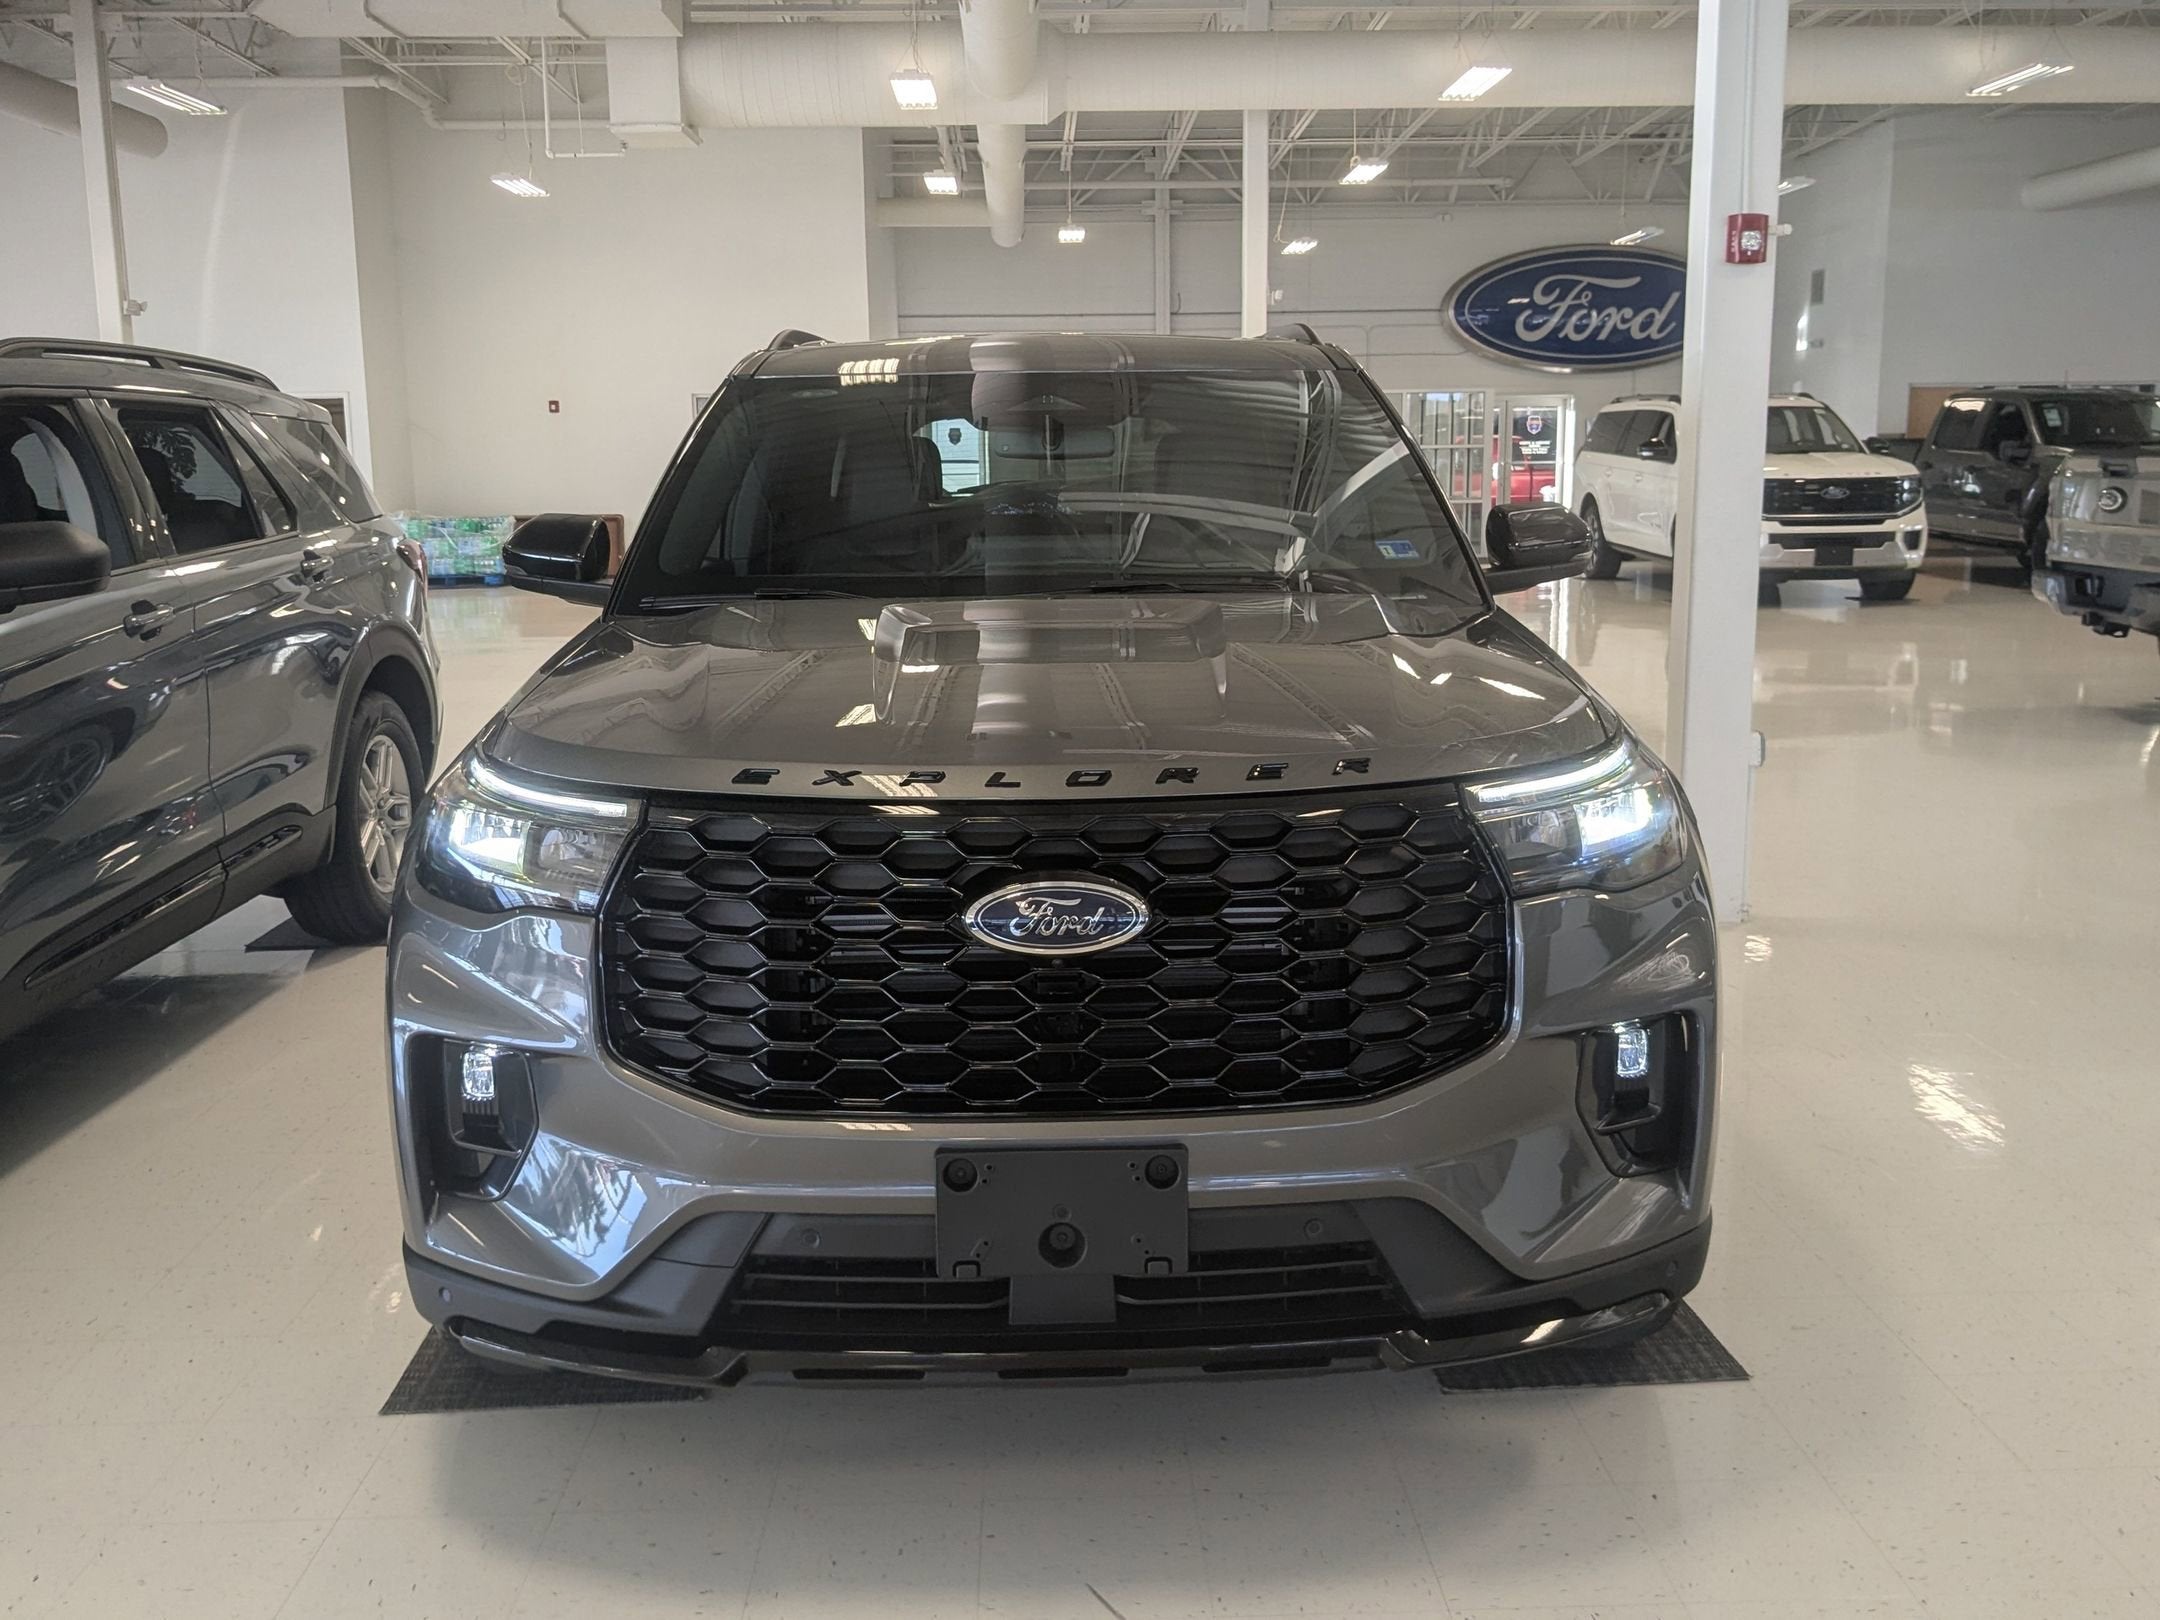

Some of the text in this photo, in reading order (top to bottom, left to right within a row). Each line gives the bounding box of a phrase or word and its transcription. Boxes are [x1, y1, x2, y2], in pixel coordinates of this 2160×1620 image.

[1514, 274, 1681, 342] Ford
[731, 757, 1371, 788] EXPLORER
[1009, 896, 1105, 937] Ford
